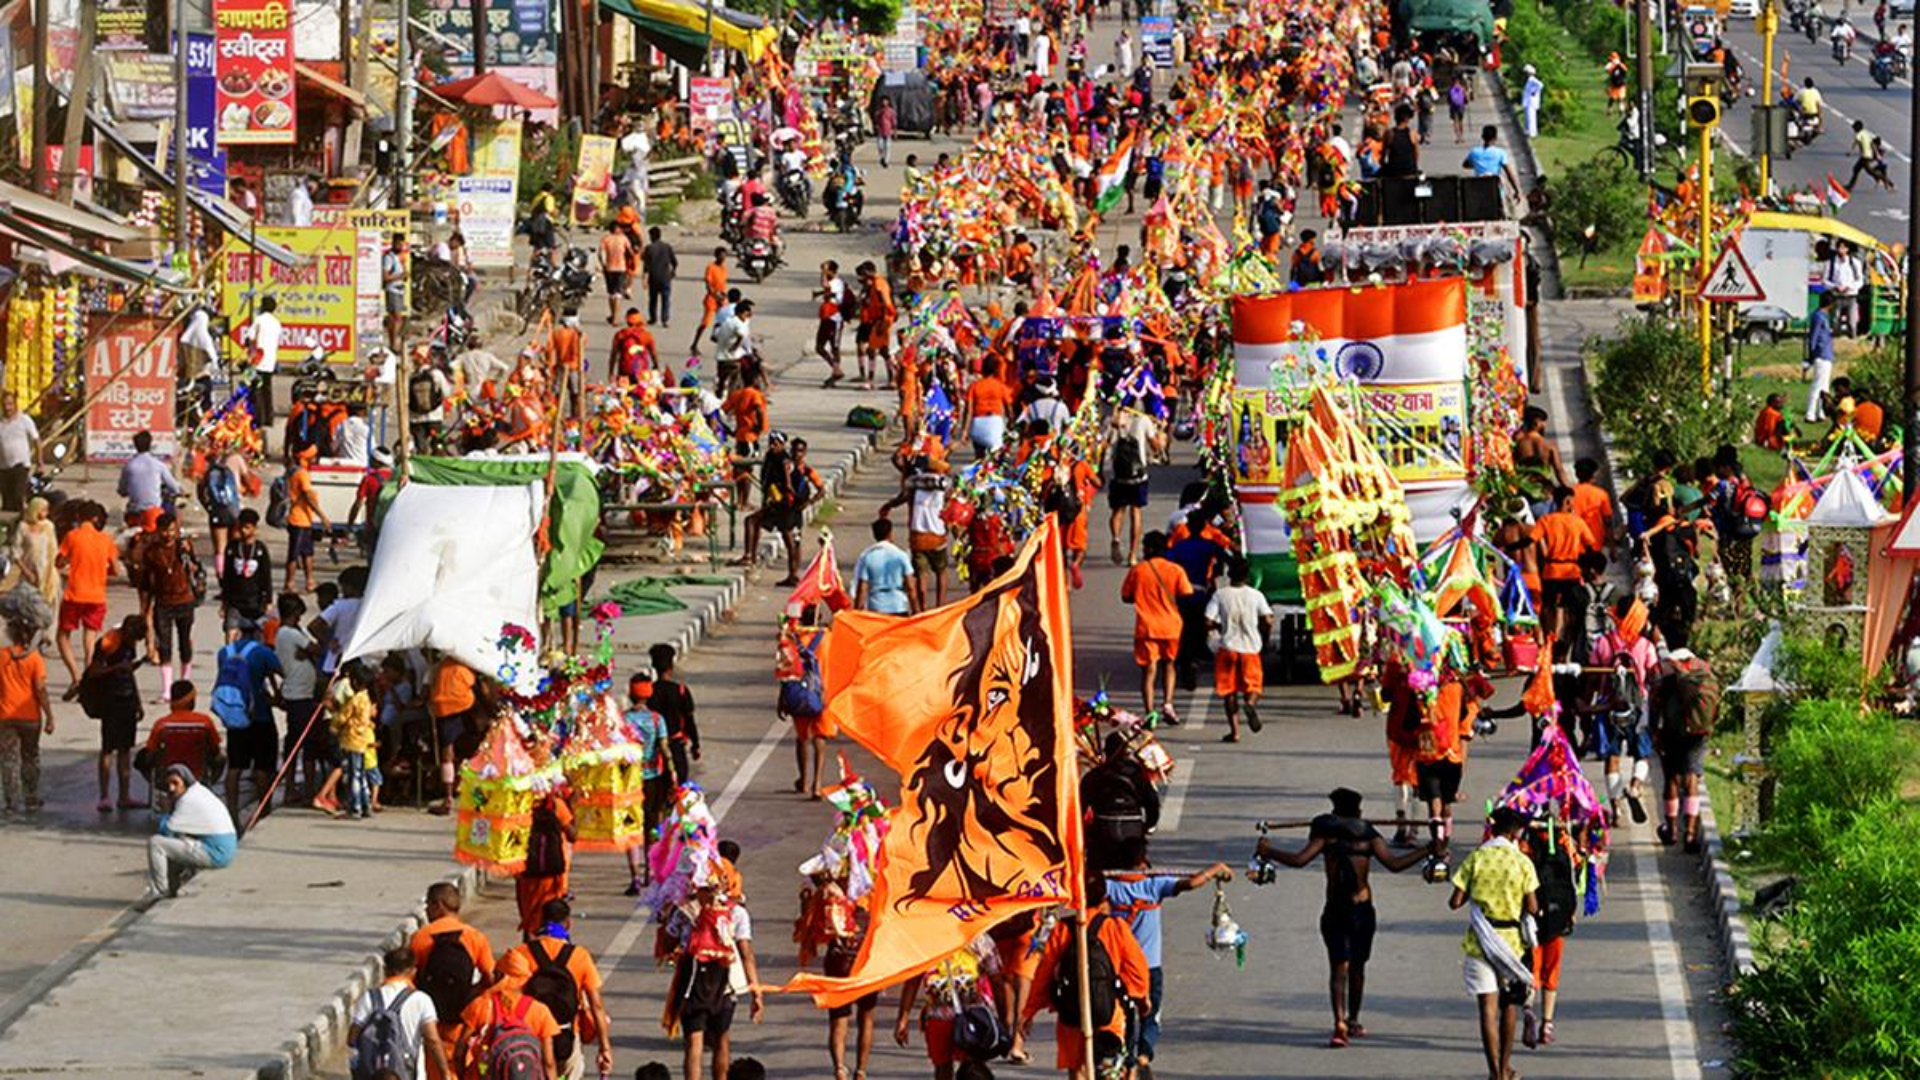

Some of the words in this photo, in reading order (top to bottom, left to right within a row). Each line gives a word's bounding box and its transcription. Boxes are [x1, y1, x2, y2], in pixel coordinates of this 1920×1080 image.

[217, 1, 287, 29] गणपति
[239, 326, 347, 349] PRMACY
[1402, 392, 1434, 411] यात्रा
[109, 403, 153, 430] स्टोर
